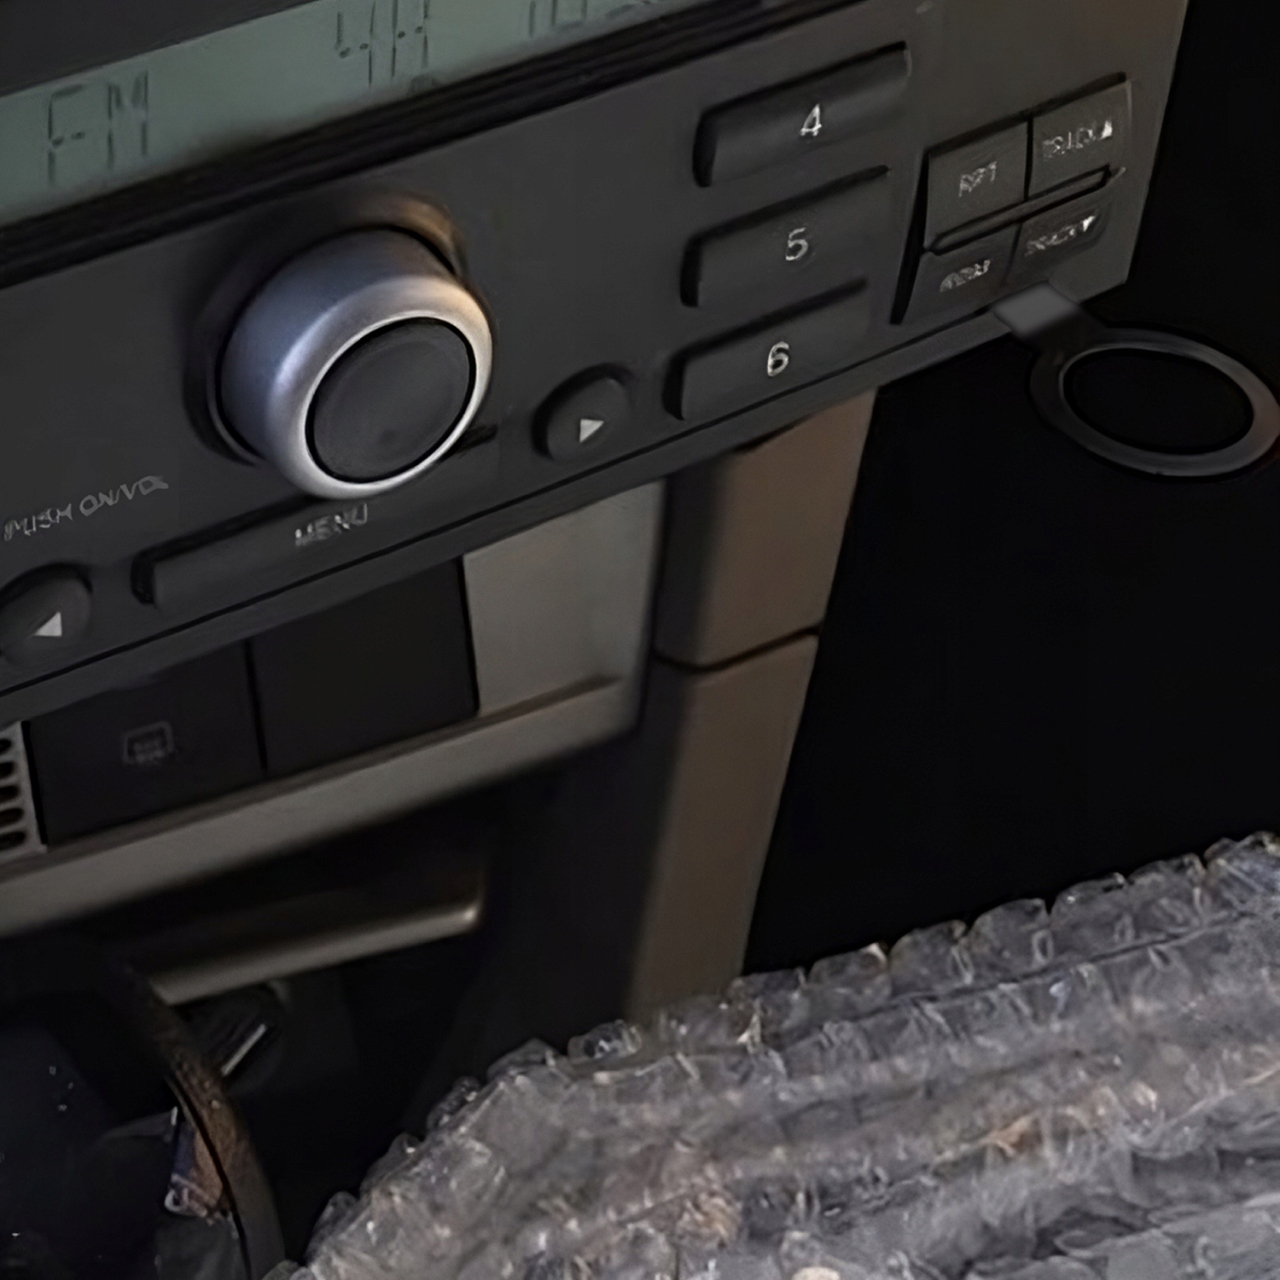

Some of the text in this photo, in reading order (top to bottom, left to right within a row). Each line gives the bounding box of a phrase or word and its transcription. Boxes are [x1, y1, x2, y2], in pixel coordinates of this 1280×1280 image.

[46, 69, 150, 186] FM
[799, 103, 823, 136] 4
[785, 227, 809, 261] 5
[767, 341, 790, 377] 6
